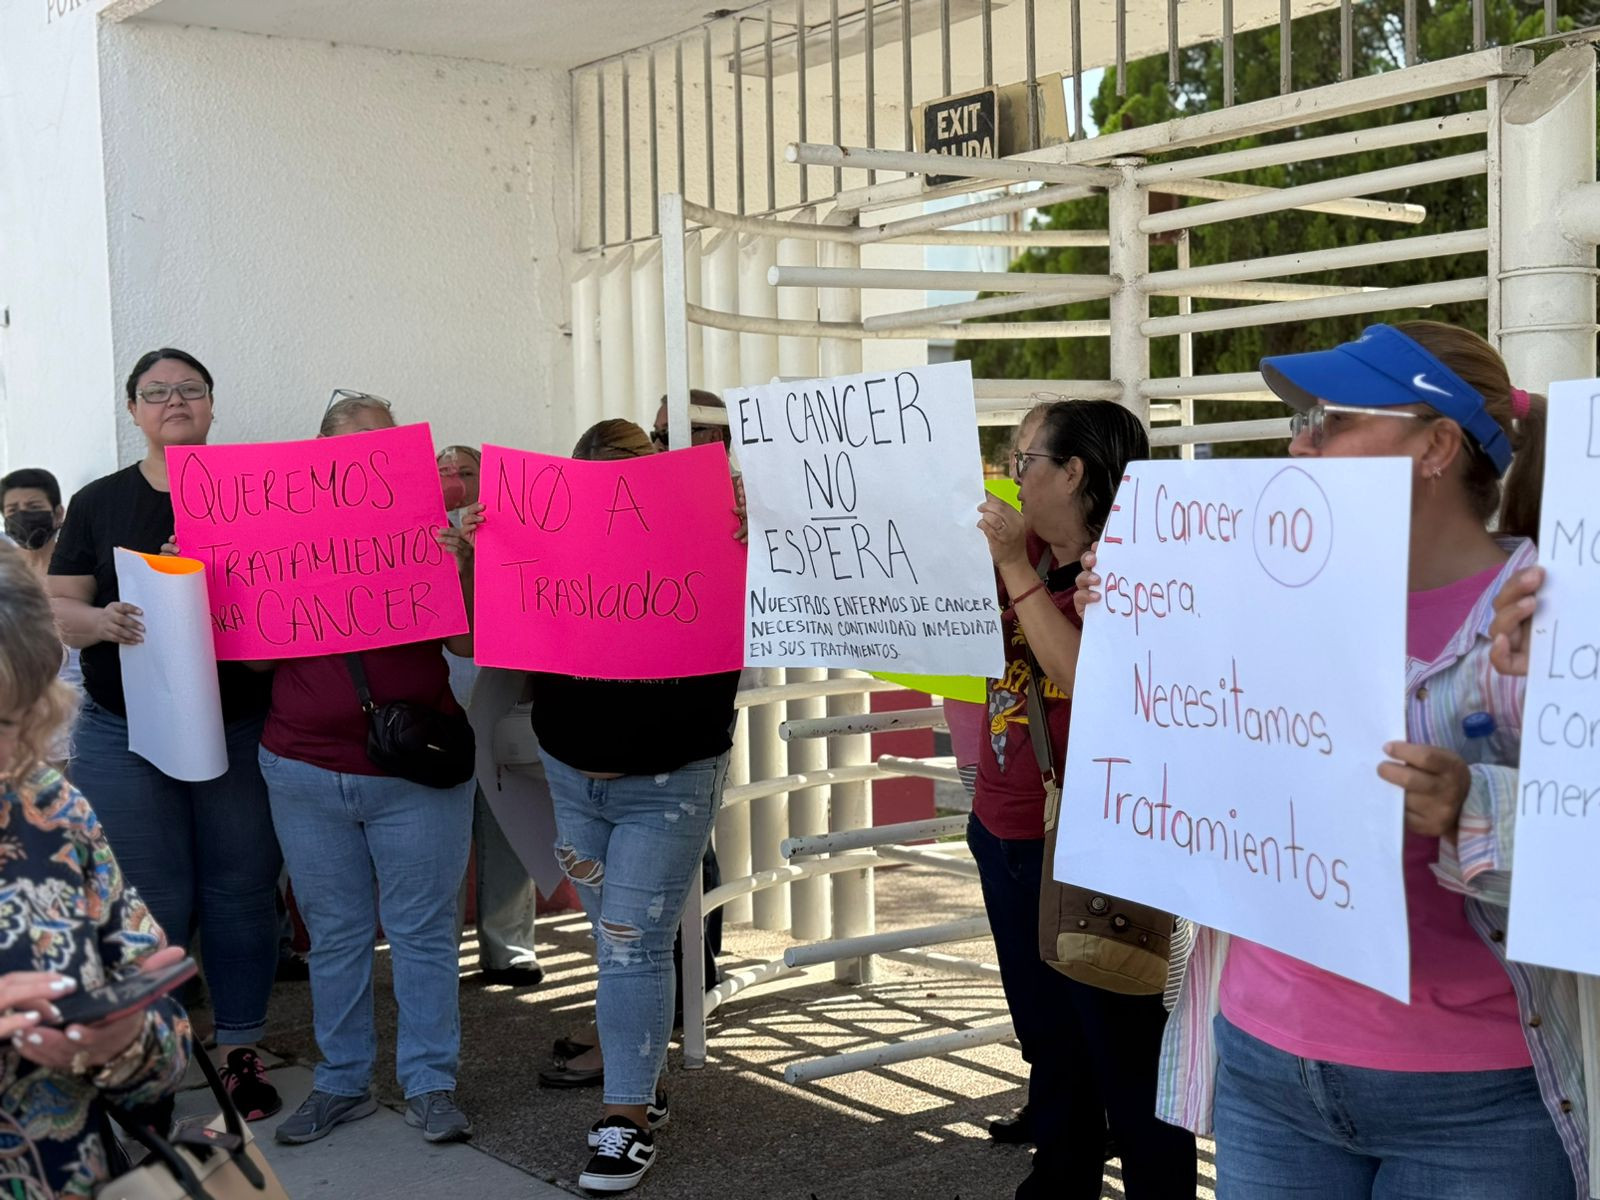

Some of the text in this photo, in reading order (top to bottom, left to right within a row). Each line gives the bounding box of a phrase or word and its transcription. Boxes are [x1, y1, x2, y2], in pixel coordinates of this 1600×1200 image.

[937, 102, 982, 140] EXIT
[738, 371, 932, 447] EL CANCER
[180, 450, 394, 524] QUEREMOS
[605, 475, 650, 536] A
[804, 451, 857, 513] NO
[1155, 484, 1244, 545] Cancer
[199, 525, 444, 587] TRATAMIENTOS
[765, 520, 918, 584] ESPERA
[209, 582, 439, 645] ARA CANCER
[750, 587, 996, 618] NUESTROS ENFERMOS DE CANCER
[751, 619, 999, 639] NECESITAN CONTINUIDAD INMEDIATA
[1105, 572, 1201, 636] espera.
[750, 641, 773, 658] EN
[778, 641, 806, 657] SUS
[1134, 649, 1333, 756] Necesitamos
[1092, 757, 1355, 911] Tratamientos.
